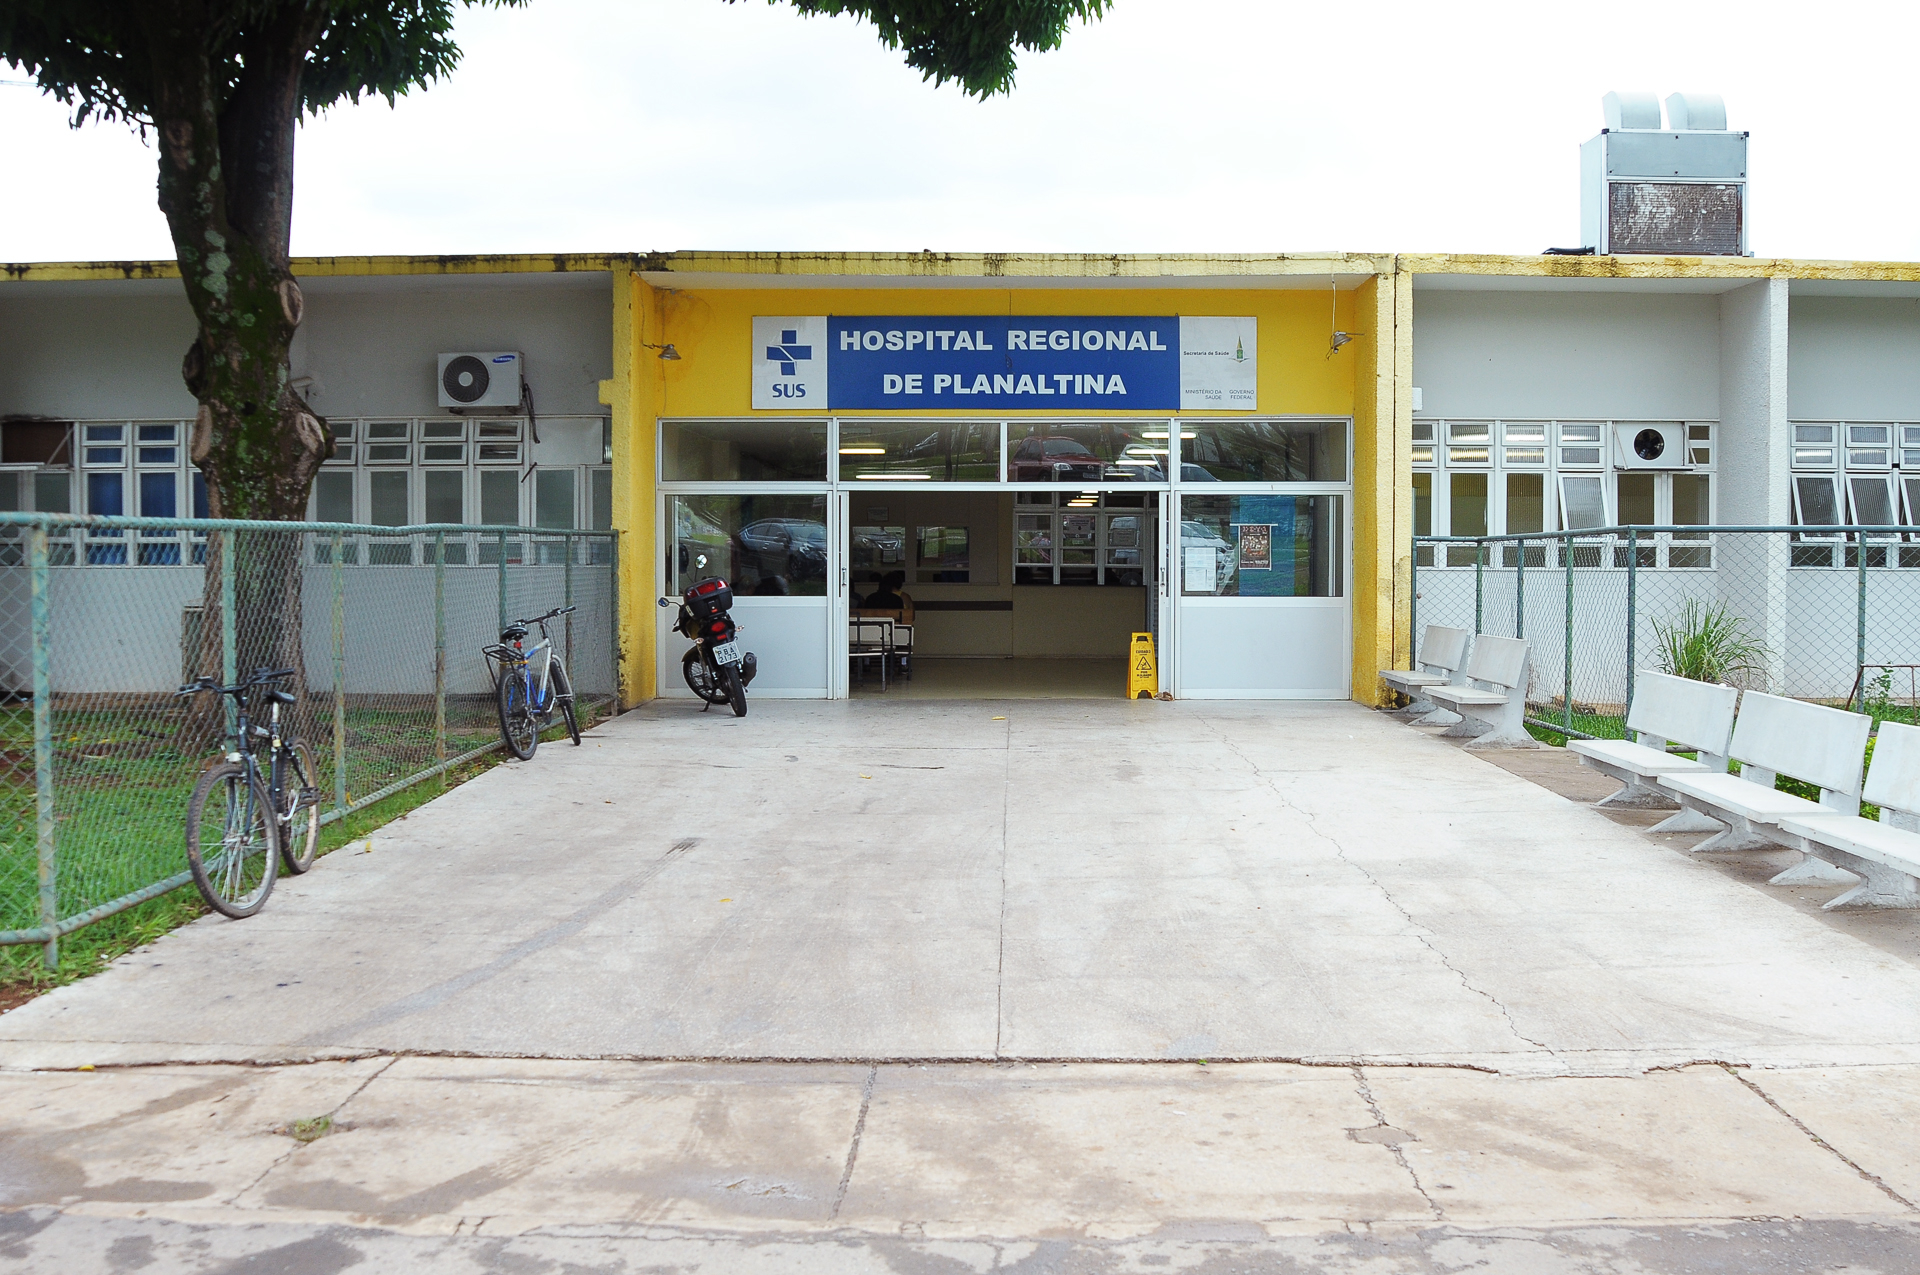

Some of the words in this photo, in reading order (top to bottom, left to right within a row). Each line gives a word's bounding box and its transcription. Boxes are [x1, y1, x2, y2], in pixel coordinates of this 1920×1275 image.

[840, 330, 993, 351] HOSPITAL
[1007, 330, 1167, 351] REGIONAL
[772, 383, 806, 398] SUS
[883, 374, 923, 395] DE
[934, 374, 1127, 395] PLANALTINA
[719, 653, 737, 663] 2173
